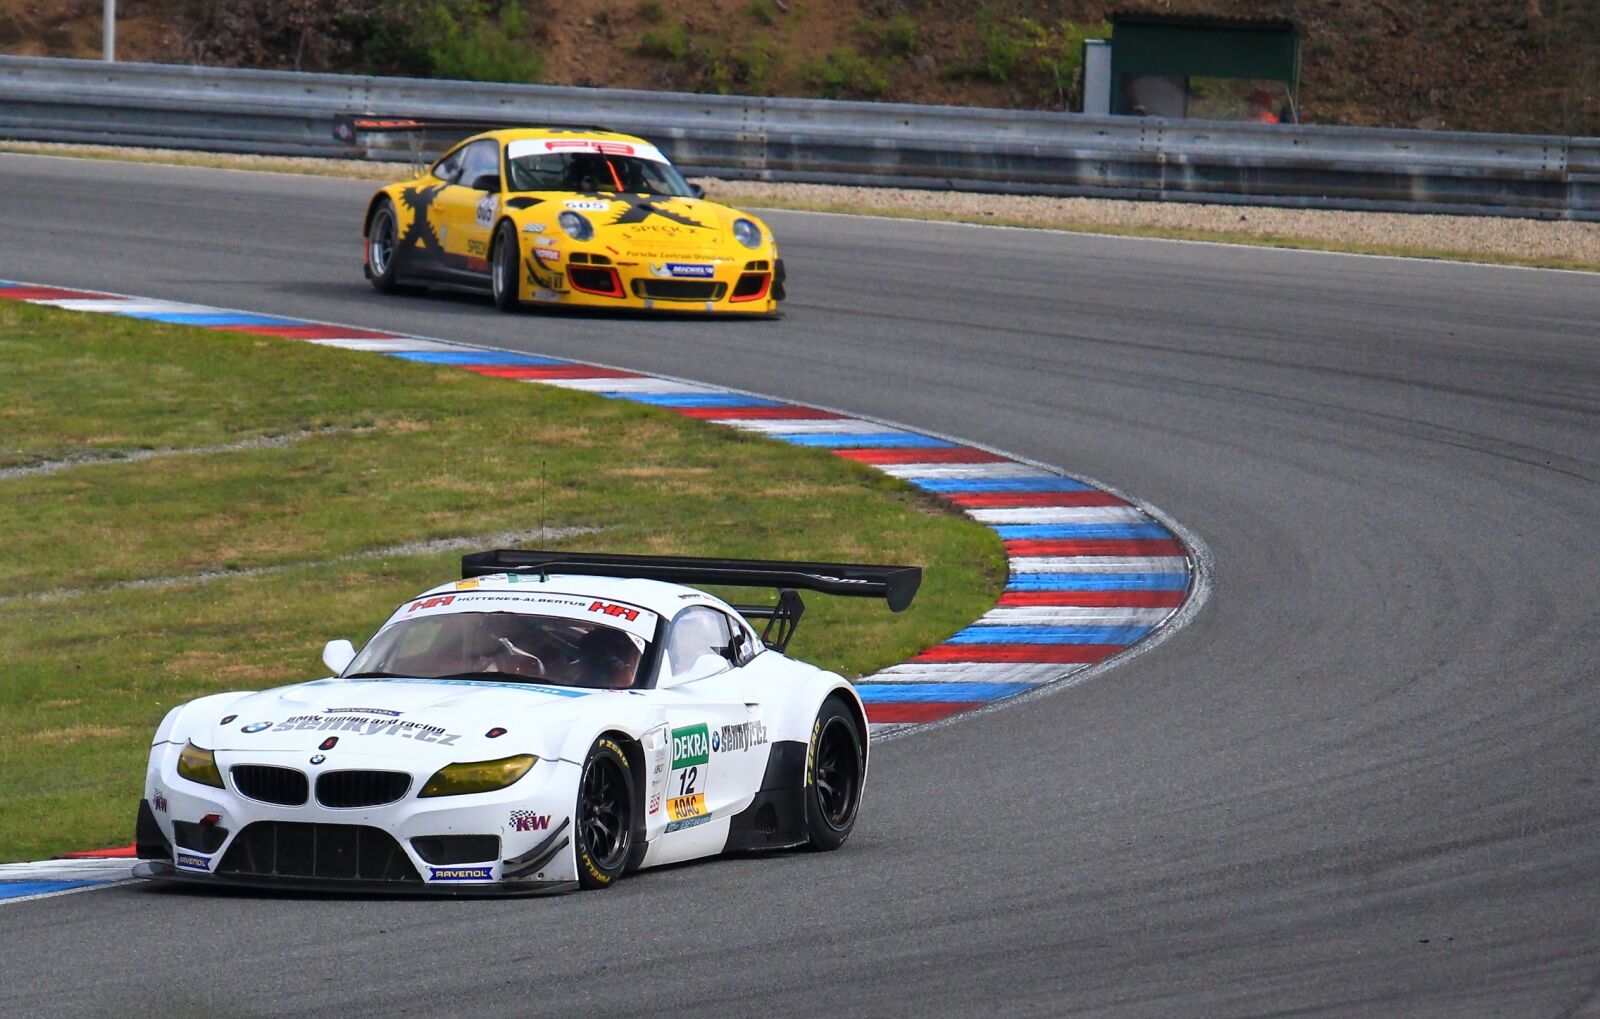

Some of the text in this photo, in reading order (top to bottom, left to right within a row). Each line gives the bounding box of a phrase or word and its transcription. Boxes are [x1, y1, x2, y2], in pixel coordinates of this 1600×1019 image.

[400, 721, 446, 734] racing
[674, 732, 708, 761] DEKRA
[680, 766, 698, 796] 12
[674, 796, 700, 818] ADAC
[516, 815, 552, 831] KW
[436, 870, 487, 878] RAVENOL
